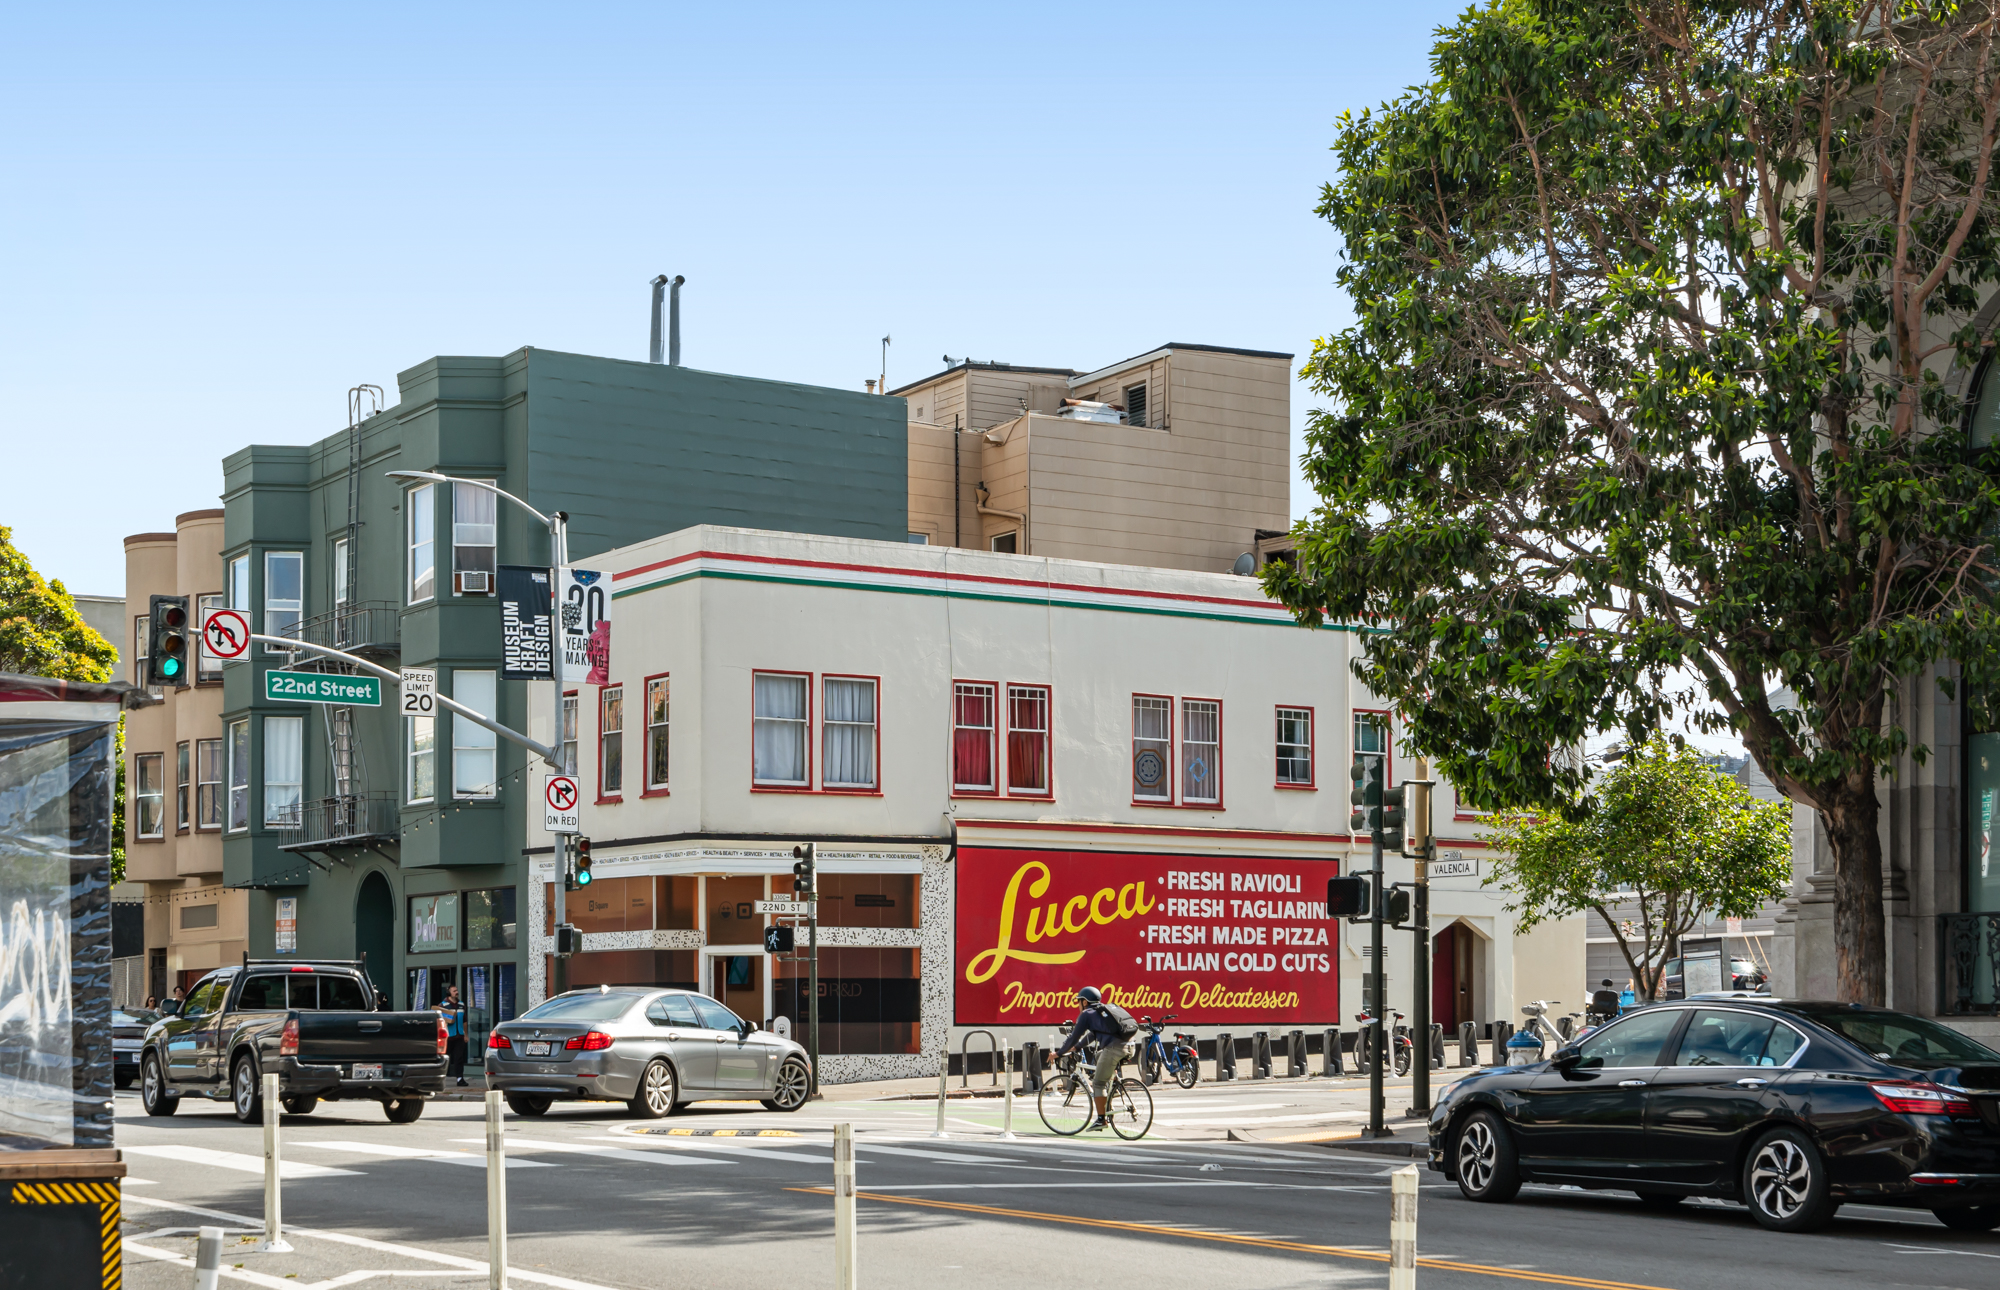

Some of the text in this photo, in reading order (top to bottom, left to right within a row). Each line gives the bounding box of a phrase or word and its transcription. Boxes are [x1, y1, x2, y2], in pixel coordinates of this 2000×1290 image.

[567, 584, 604, 635] 20
[503, 601, 520, 671] MUSEUM
[534, 615, 550, 672] DESIGN
[566, 637, 594, 652] YEARS
[520, 621, 536, 672] CRAFT
[566, 651, 604, 667] MAKING
[403, 672, 434, 682] SPEED
[271, 677, 372, 699] 22nd Street
[406, 683, 430, 692] LIMIT
[405, 693, 433, 712] 20
[547, 815, 577, 826] ON RED
[1434, 863, 1470, 874] VALENCIA
[1167, 871, 1301, 893] FRESH RAVIOLI
[595, 902, 609, 911] Square
[762, 903, 801, 912] 22ND ST
[1167, 898, 1225, 918] FRESH
[966, 861, 1156, 984] Lucca
[1147, 925, 1329, 946] FRESH MADE PIZZA
[1146, 952, 1330, 973] ITALIAN COLD CUTS
[1000, 980, 1300, 1014] Importe Italian Delicatessen
